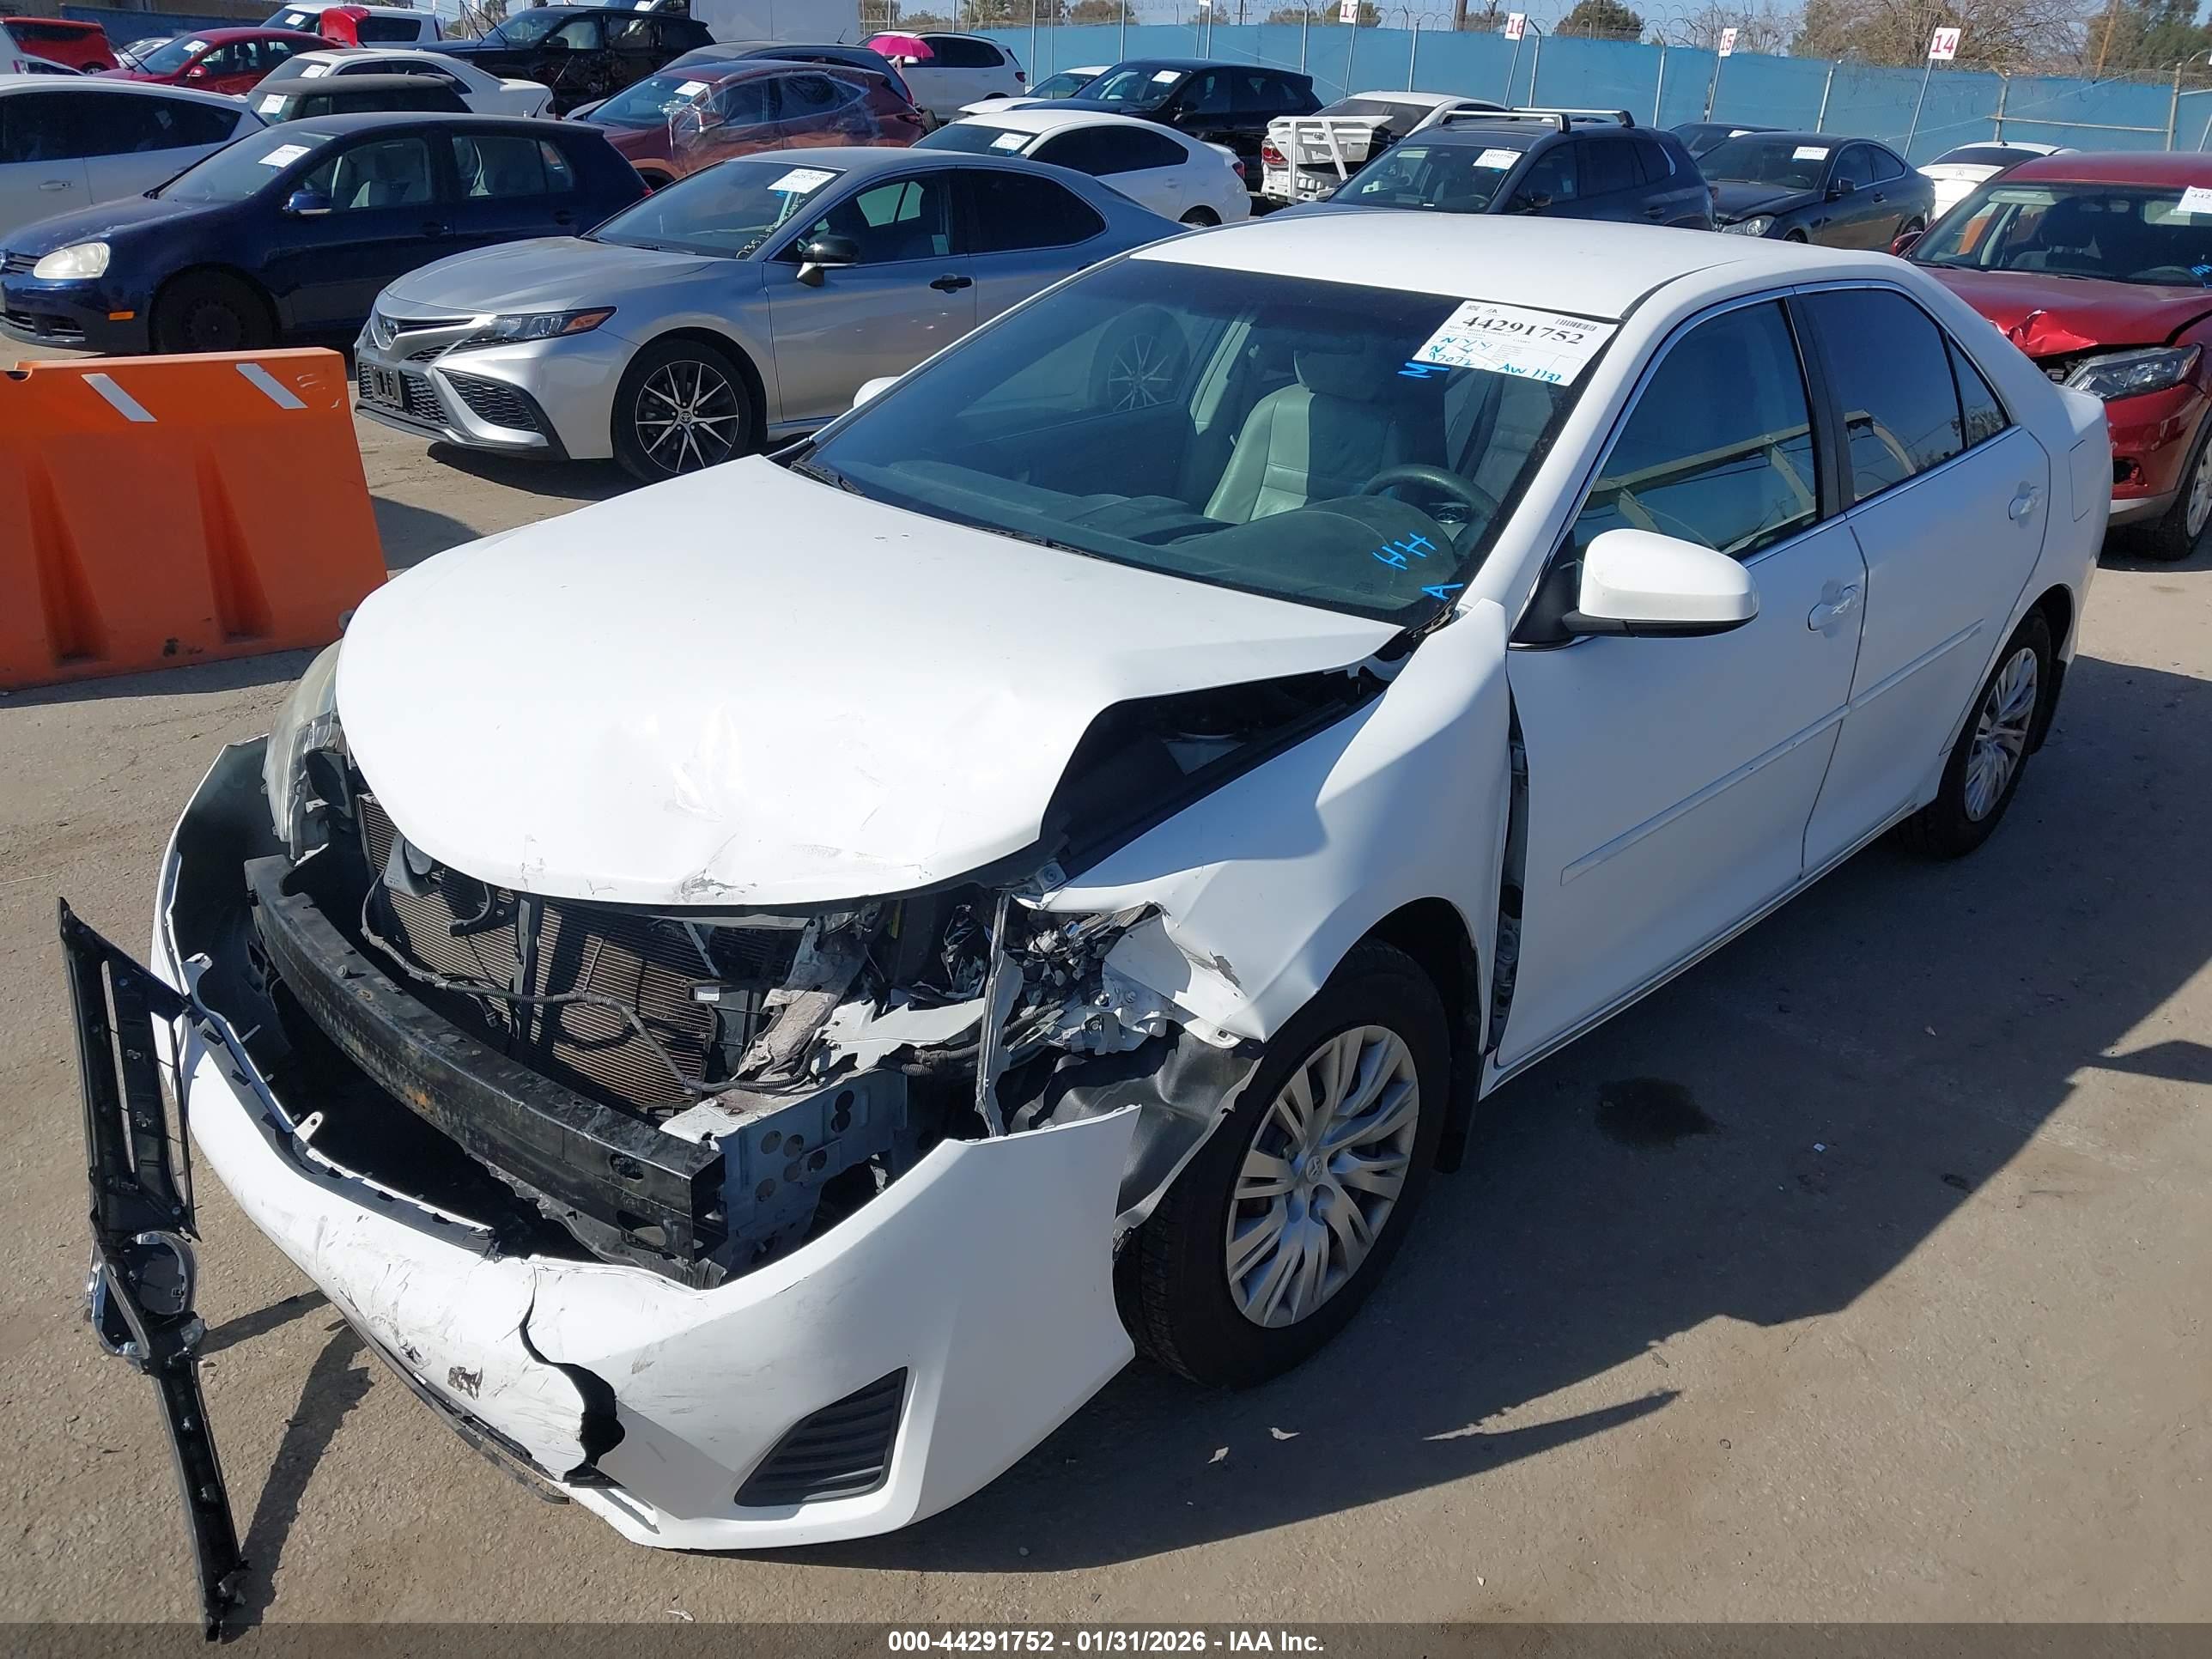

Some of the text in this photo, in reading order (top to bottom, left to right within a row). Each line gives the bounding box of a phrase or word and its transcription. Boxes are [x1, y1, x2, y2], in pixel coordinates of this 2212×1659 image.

[1340, 3, 1358, 18] 17
[1721, 33, 1735, 51] 15
[1931, 33, 1956, 53] 14
[1462, 316, 1584, 344] 44291752
